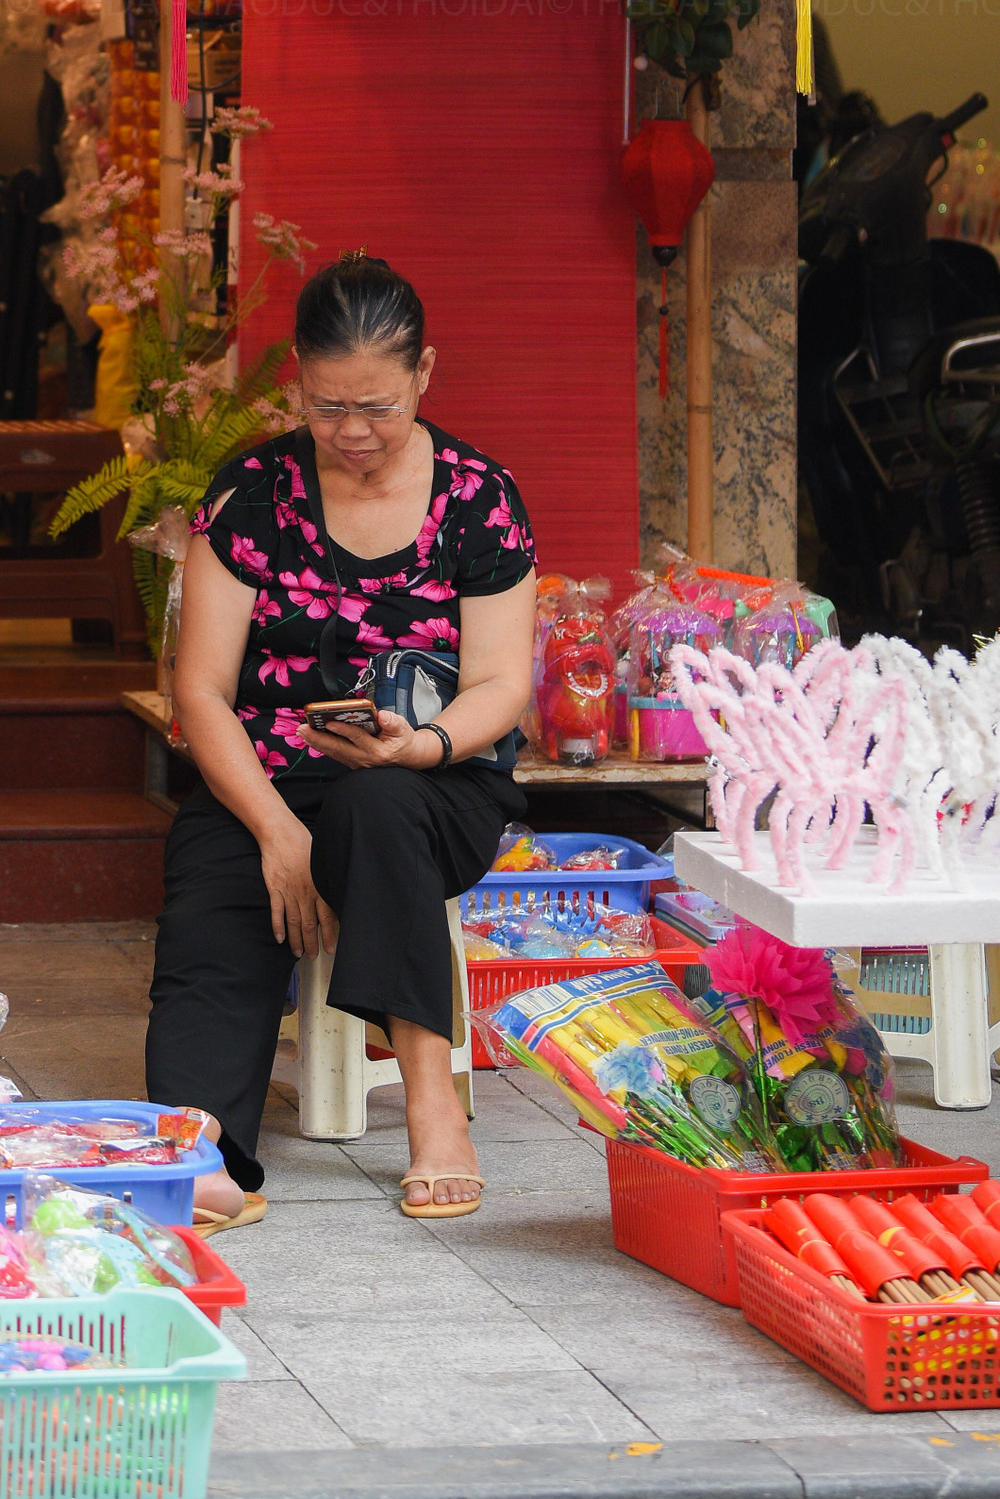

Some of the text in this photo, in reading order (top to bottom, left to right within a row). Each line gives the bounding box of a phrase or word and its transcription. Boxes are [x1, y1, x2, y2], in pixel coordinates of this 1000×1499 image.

[687, 1038, 715, 1053] FRESH
[763, 1040, 823, 1072] FRESH FLOWER
